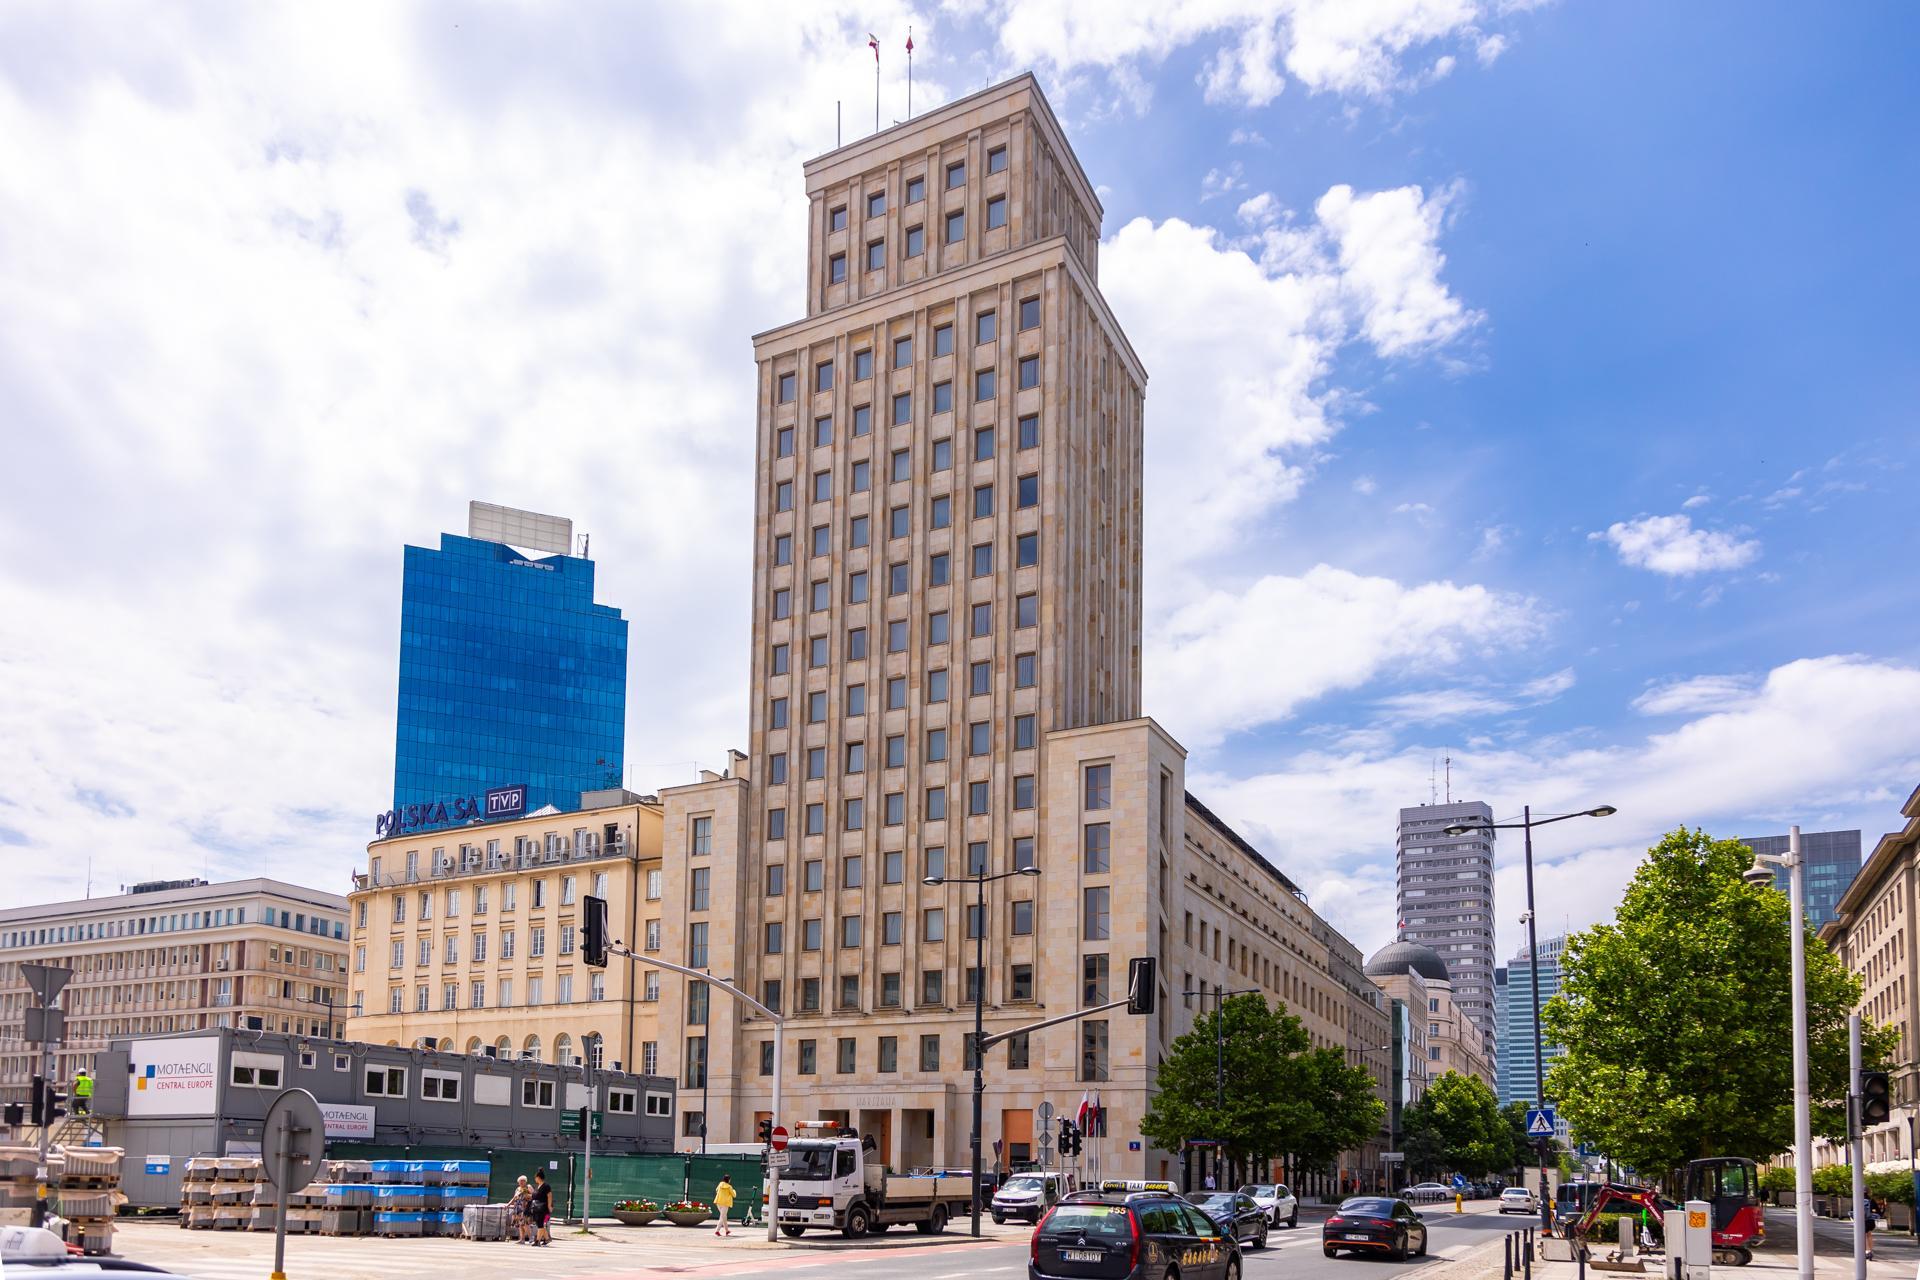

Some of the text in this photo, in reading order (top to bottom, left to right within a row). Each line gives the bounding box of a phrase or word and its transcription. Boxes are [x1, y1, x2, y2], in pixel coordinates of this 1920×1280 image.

[490, 792, 520, 810] TVP
[376, 795, 480, 835] POLSKA SA
[157, 1080, 213, 1090] CENTRAL EUROPE
[346, 1123, 369, 1131] EUROPE
[1129, 1182, 1143, 1191] TAXI
